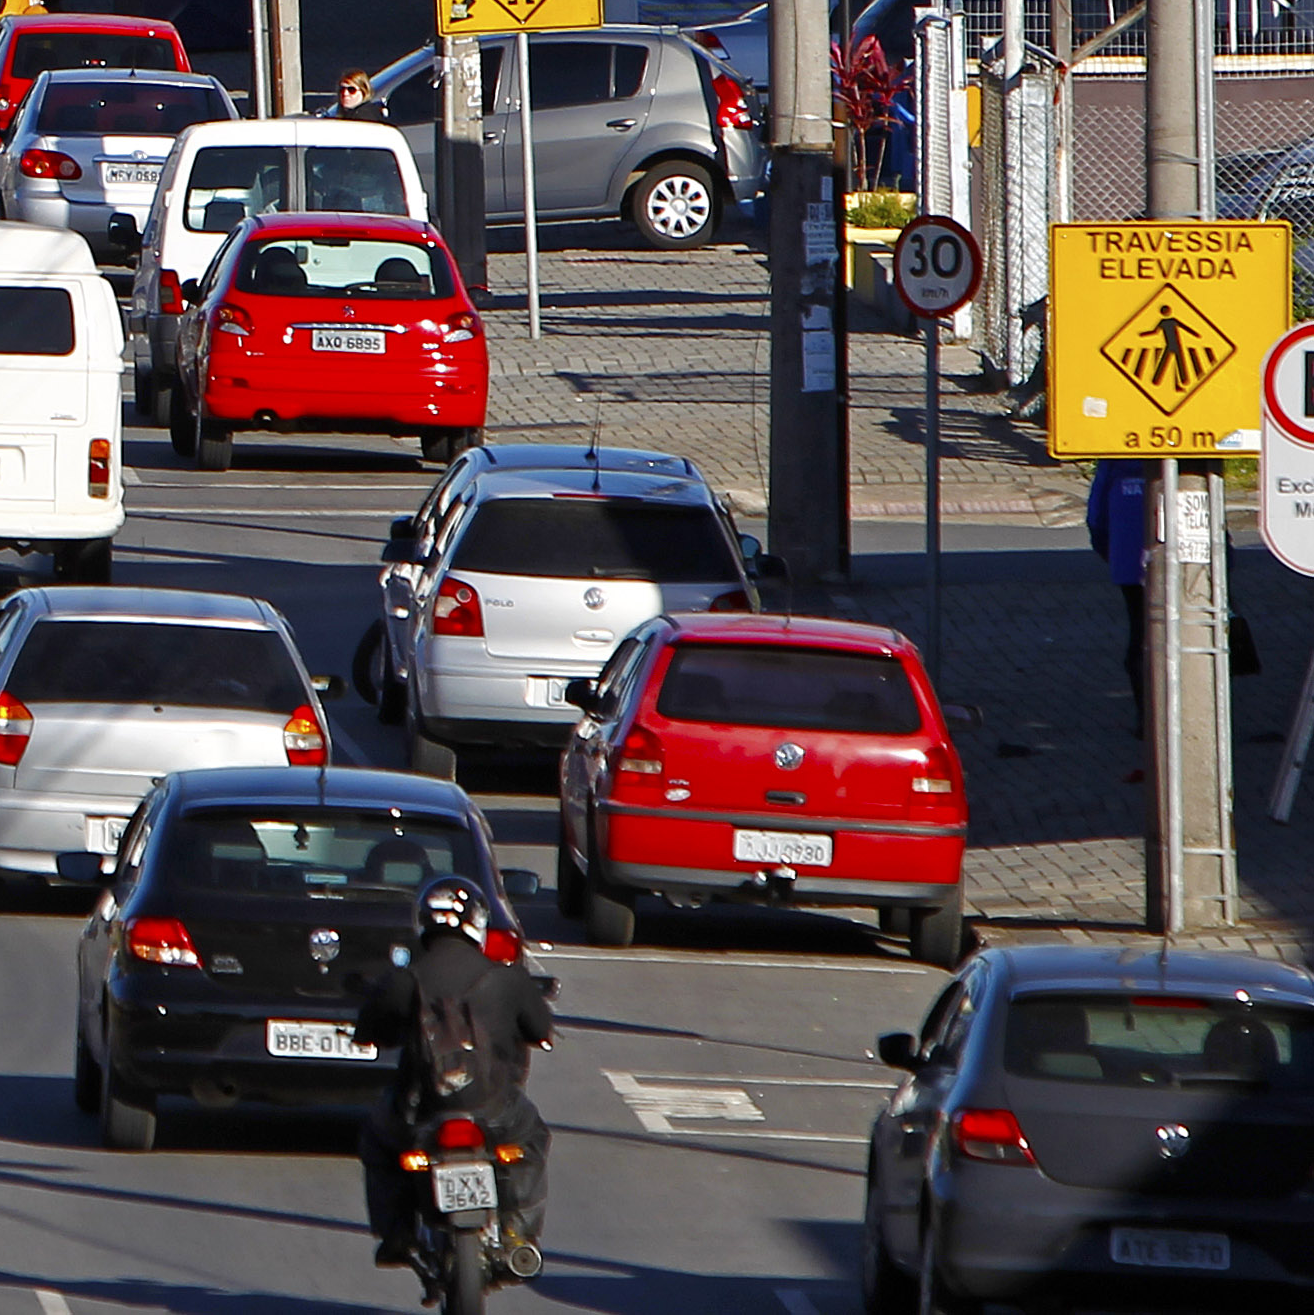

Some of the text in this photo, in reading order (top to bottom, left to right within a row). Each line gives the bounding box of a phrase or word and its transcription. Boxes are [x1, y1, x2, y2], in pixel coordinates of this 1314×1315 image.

[1086, 230, 1254, 254] TRAVESSIA
[909, 233, 964, 280] 30
[1100, 258, 1238, 281] ELEVADA
[1125, 426, 1216, 449] a 50 m
[1279, 477, 1314, 494] Exc
[485, 598, 515, 608] POLO
